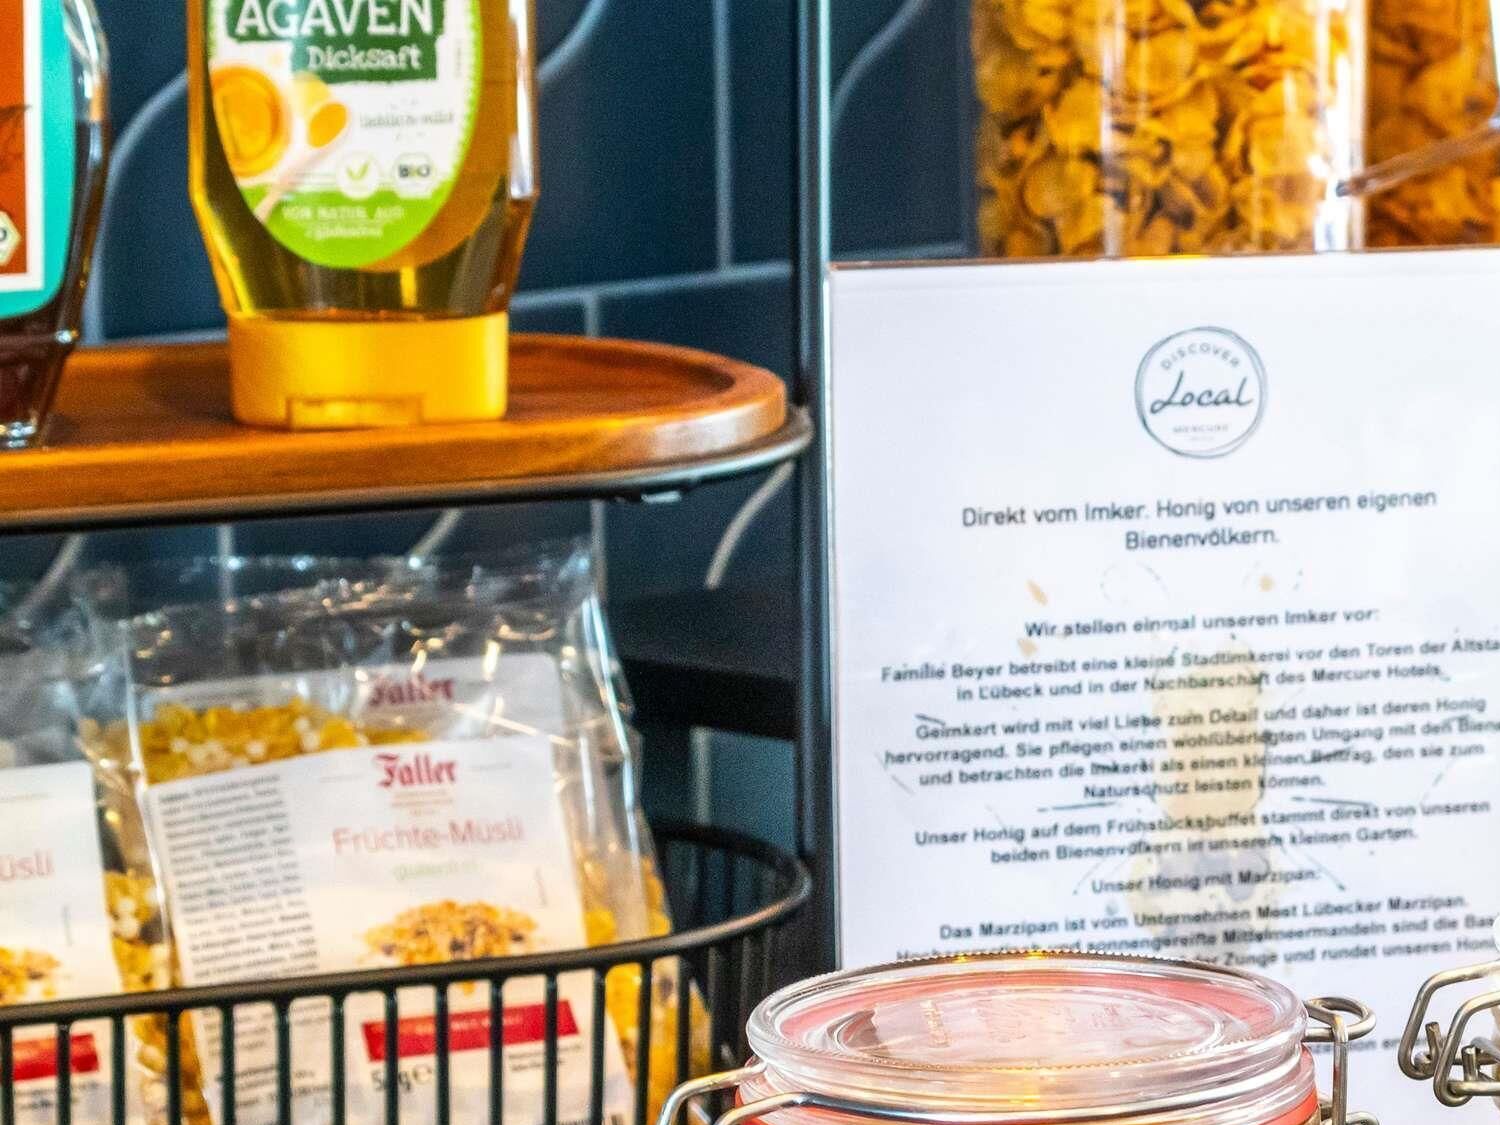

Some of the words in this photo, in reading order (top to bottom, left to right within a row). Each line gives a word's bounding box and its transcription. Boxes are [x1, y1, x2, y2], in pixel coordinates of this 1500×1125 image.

[235, 0, 433, 35] AGAVEN
[398, 163, 431, 178] BIO
[1161, 342, 1240, 370] DISCOVER
[1150, 369, 1255, 415] Local
[962, 506, 1026, 528] Direkt
[1033, 505, 1077, 523] vom
[1085, 500, 1149, 522] Imker.
[1156, 499, 1216, 521] Honig
[1222, 498, 1260, 515] von
[1266, 494, 1350, 513] unseren
[1357, 490, 1437, 512] eigenen
[1125, 528, 1280, 550] Bienenvölkern.
[1026, 620, 1056, 637] Wir
[1063, 620, 1126, 636] stellen
[1133, 614, 1195, 632] einmal
[1202, 612, 1278, 629] unseren
[1284, 608, 1337, 625] Imker
[1343, 608, 1379, 622] vor:
[881, 663, 945, 682] Familie
[951, 663, 1002, 681] Beyer
[1009, 658, 1076, 676] betreibt
[1082, 656, 1118, 672] eine
[1124, 654, 1175, 670] kleine
[1182, 647, 1289, 667] Stadtimkerei
[1296, 648, 1323, 662] vor
[1329, 645, 1360, 659] den
[1367, 642, 1414, 658] Toren
[1419, 640, 1446, 656] der
[957, 686, 973, 701] in
[979, 684, 1043, 700] Lübeck
[1049, 680, 1081, 696] und
[1088, 678, 1104, 694] in
[1110, 677, 1137, 693] der
[1143, 671, 1270, 691] Nachbarschaft
[1275, 669, 1305, 685] des
[1311, 666, 1380, 682] Mercure
[916, 723, 997, 741] Geimkert
[1003, 718, 1039, 735] wird
[1045, 717, 1073, 732] mit
[1080, 715, 1109, 731] viel
[1114, 714, 1162, 730] Liebe
[1168, 712, 1202, 728] zum
[1209, 707, 1258, 724] Detail
[1264, 704, 1296, 720] und
[1303, 702, 1350, 720] daher
[1356, 700, 1377, 716] ist
[1383, 699, 1431, 715] deren
[1436, 696, 1485, 715] Honig
[885, 743, 1008, 765] hervorragend.
[1016, 741, 1043, 757] Sie
[1049, 739, 1113, 758] pflegen
[1119, 735, 1167, 751] einen
[1312, 721, 1383, 742] Umgang
[1389, 720, 1415, 736] mit
[1421, 718, 1451, 734] den
[374, 752, 458, 788] Faller
[920, 769, 952, 786] und
[959, 766, 1052, 784] betrachten
[1059, 762, 1084, 777] die
[1090, 758, 1153, 775] Imkerei
[1160, 757, 1184, 772] als
[1190, 755, 1237, 771] einen
[1244, 751, 1305, 768] kleinen
[1383, 743, 1414, 760] den
[1420, 742, 1443, 757] sie
[1450, 742, 1485, 756] zum
[1084, 782, 1188, 799] Naturschutz
[1195, 777, 1252, 793] leisten
[1259, 773, 1325, 789] können.
[332, 816, 525, 855] Früchte-Müsli
[915, 830, 967, 847] Unser
[973, 826, 1025, 844] Honig
[1031, 823, 1058, 839] auf
[1064, 821, 1100, 837] dem
[1107, 812, 1256, 834] Frühstücksbuffet
[1262, 809, 1325, 825] stammt
[1330, 806, 1379, 822] direkt
[1386, 804, 1416, 818] von
[1422, 801, 1490, 816] unseren
[991, 848, 1049, 864] beiden
[1056, 841, 1181, 860] Bienenvölkern
[1188, 837, 1203, 851] in
[1289, 829, 1350, 845] kleinen
[1356, 826, 1418, 842] Garten.
[0, 847, 54, 881] üsli
[1092, 879, 1143, 894] Unser
[1149, 875, 1199, 892] Honig
[1205, 871, 1232, 886] mit
[940, 924, 972, 940] Das
[979, 920, 1059, 939] Marzipan
[1064, 917, 1085, 932] ist
[1091, 917, 1128, 930] vom
[1133, 910, 1249, 927] Unternehmen
[1303, 900, 1381, 918] Lübecker
[1387, 895, 1468, 913] Marzipan.
[1223, 921, 1386, 944] Mittelmeermandeln
[1392, 918, 1428, 933] sind
[1434, 916, 1458, 931] die
[1464, 913, 1494, 928] Bas
[1224, 951, 1276, 967] Zunge
[1283, 948, 1315, 962] und
[1322, 944, 1376, 961] rundet
[1382, 941, 1451, 957] unseren
[1457, 937, 1495, 951] Honi
